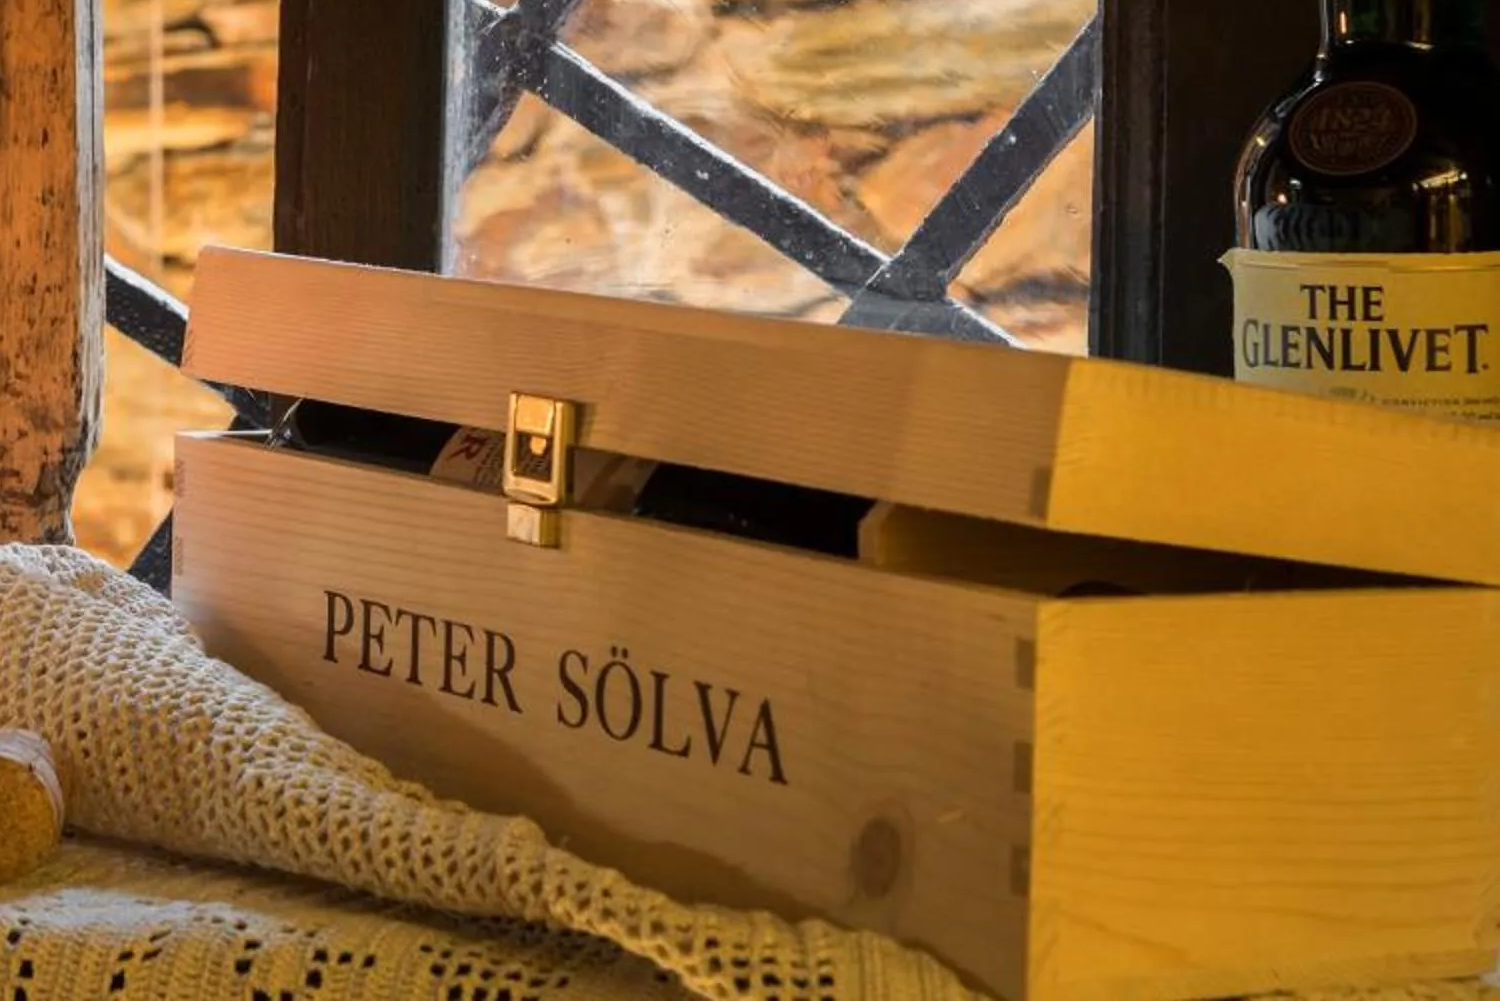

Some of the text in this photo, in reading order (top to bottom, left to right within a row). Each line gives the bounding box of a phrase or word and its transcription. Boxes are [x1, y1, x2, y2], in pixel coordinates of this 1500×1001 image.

[1300, 284, 1384, 322] THE
[322, 589, 790, 787] PETER SÖLVA
